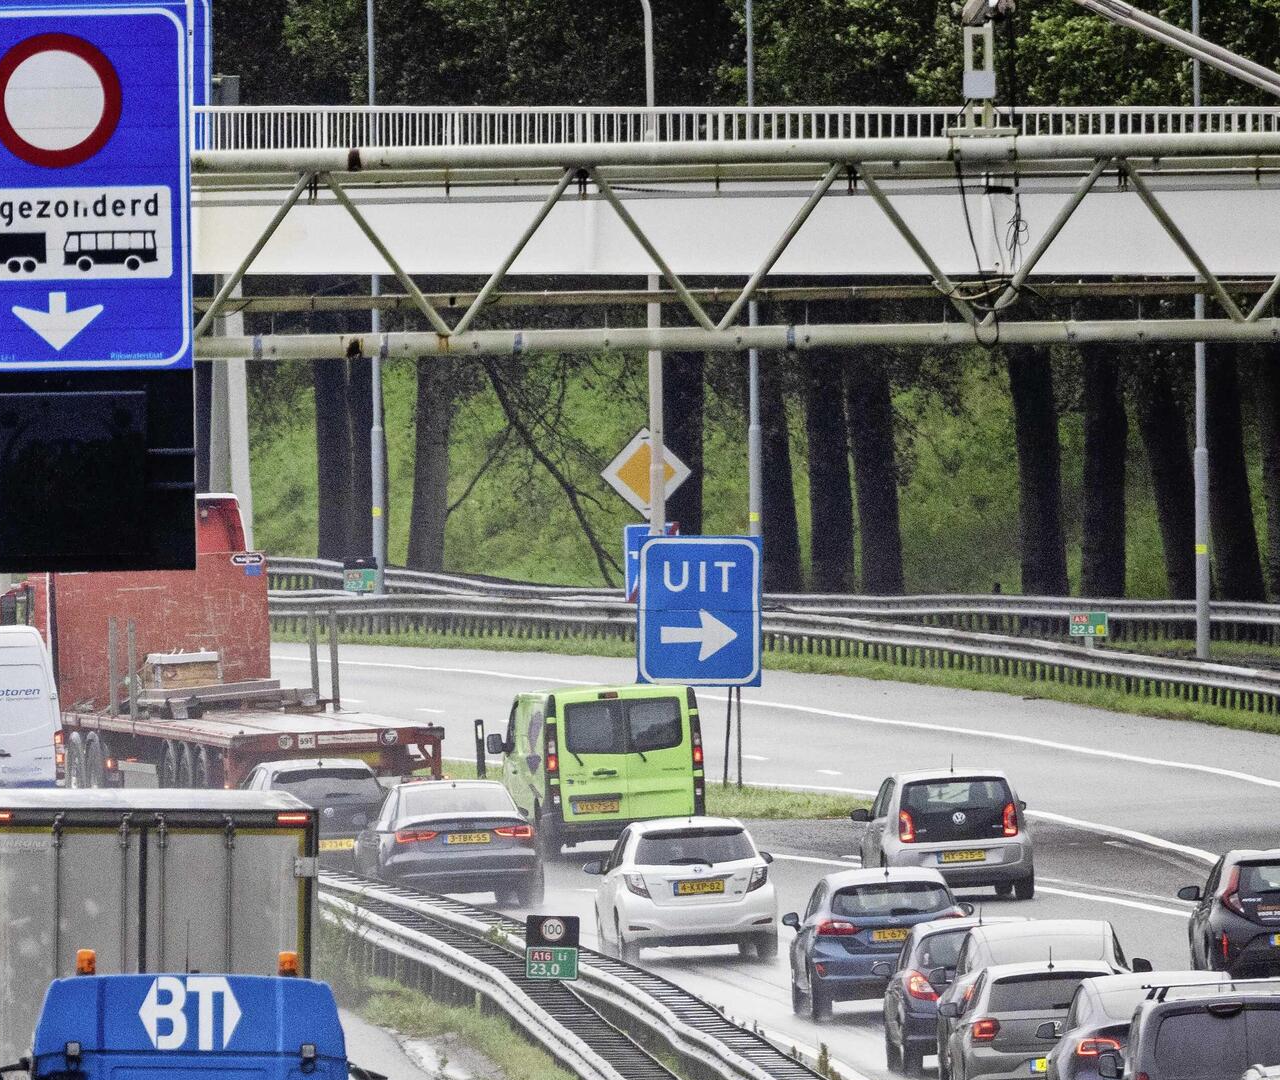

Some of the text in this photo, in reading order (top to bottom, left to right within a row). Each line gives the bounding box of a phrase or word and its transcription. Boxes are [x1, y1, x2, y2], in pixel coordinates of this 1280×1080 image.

[663, 560, 737, 593] UIT
[543, 924, 562, 936] 100
[876, 929, 908, 941] TL-679
[532, 951, 568, 961] A16 Li
[146, 976, 232, 1051] BT
